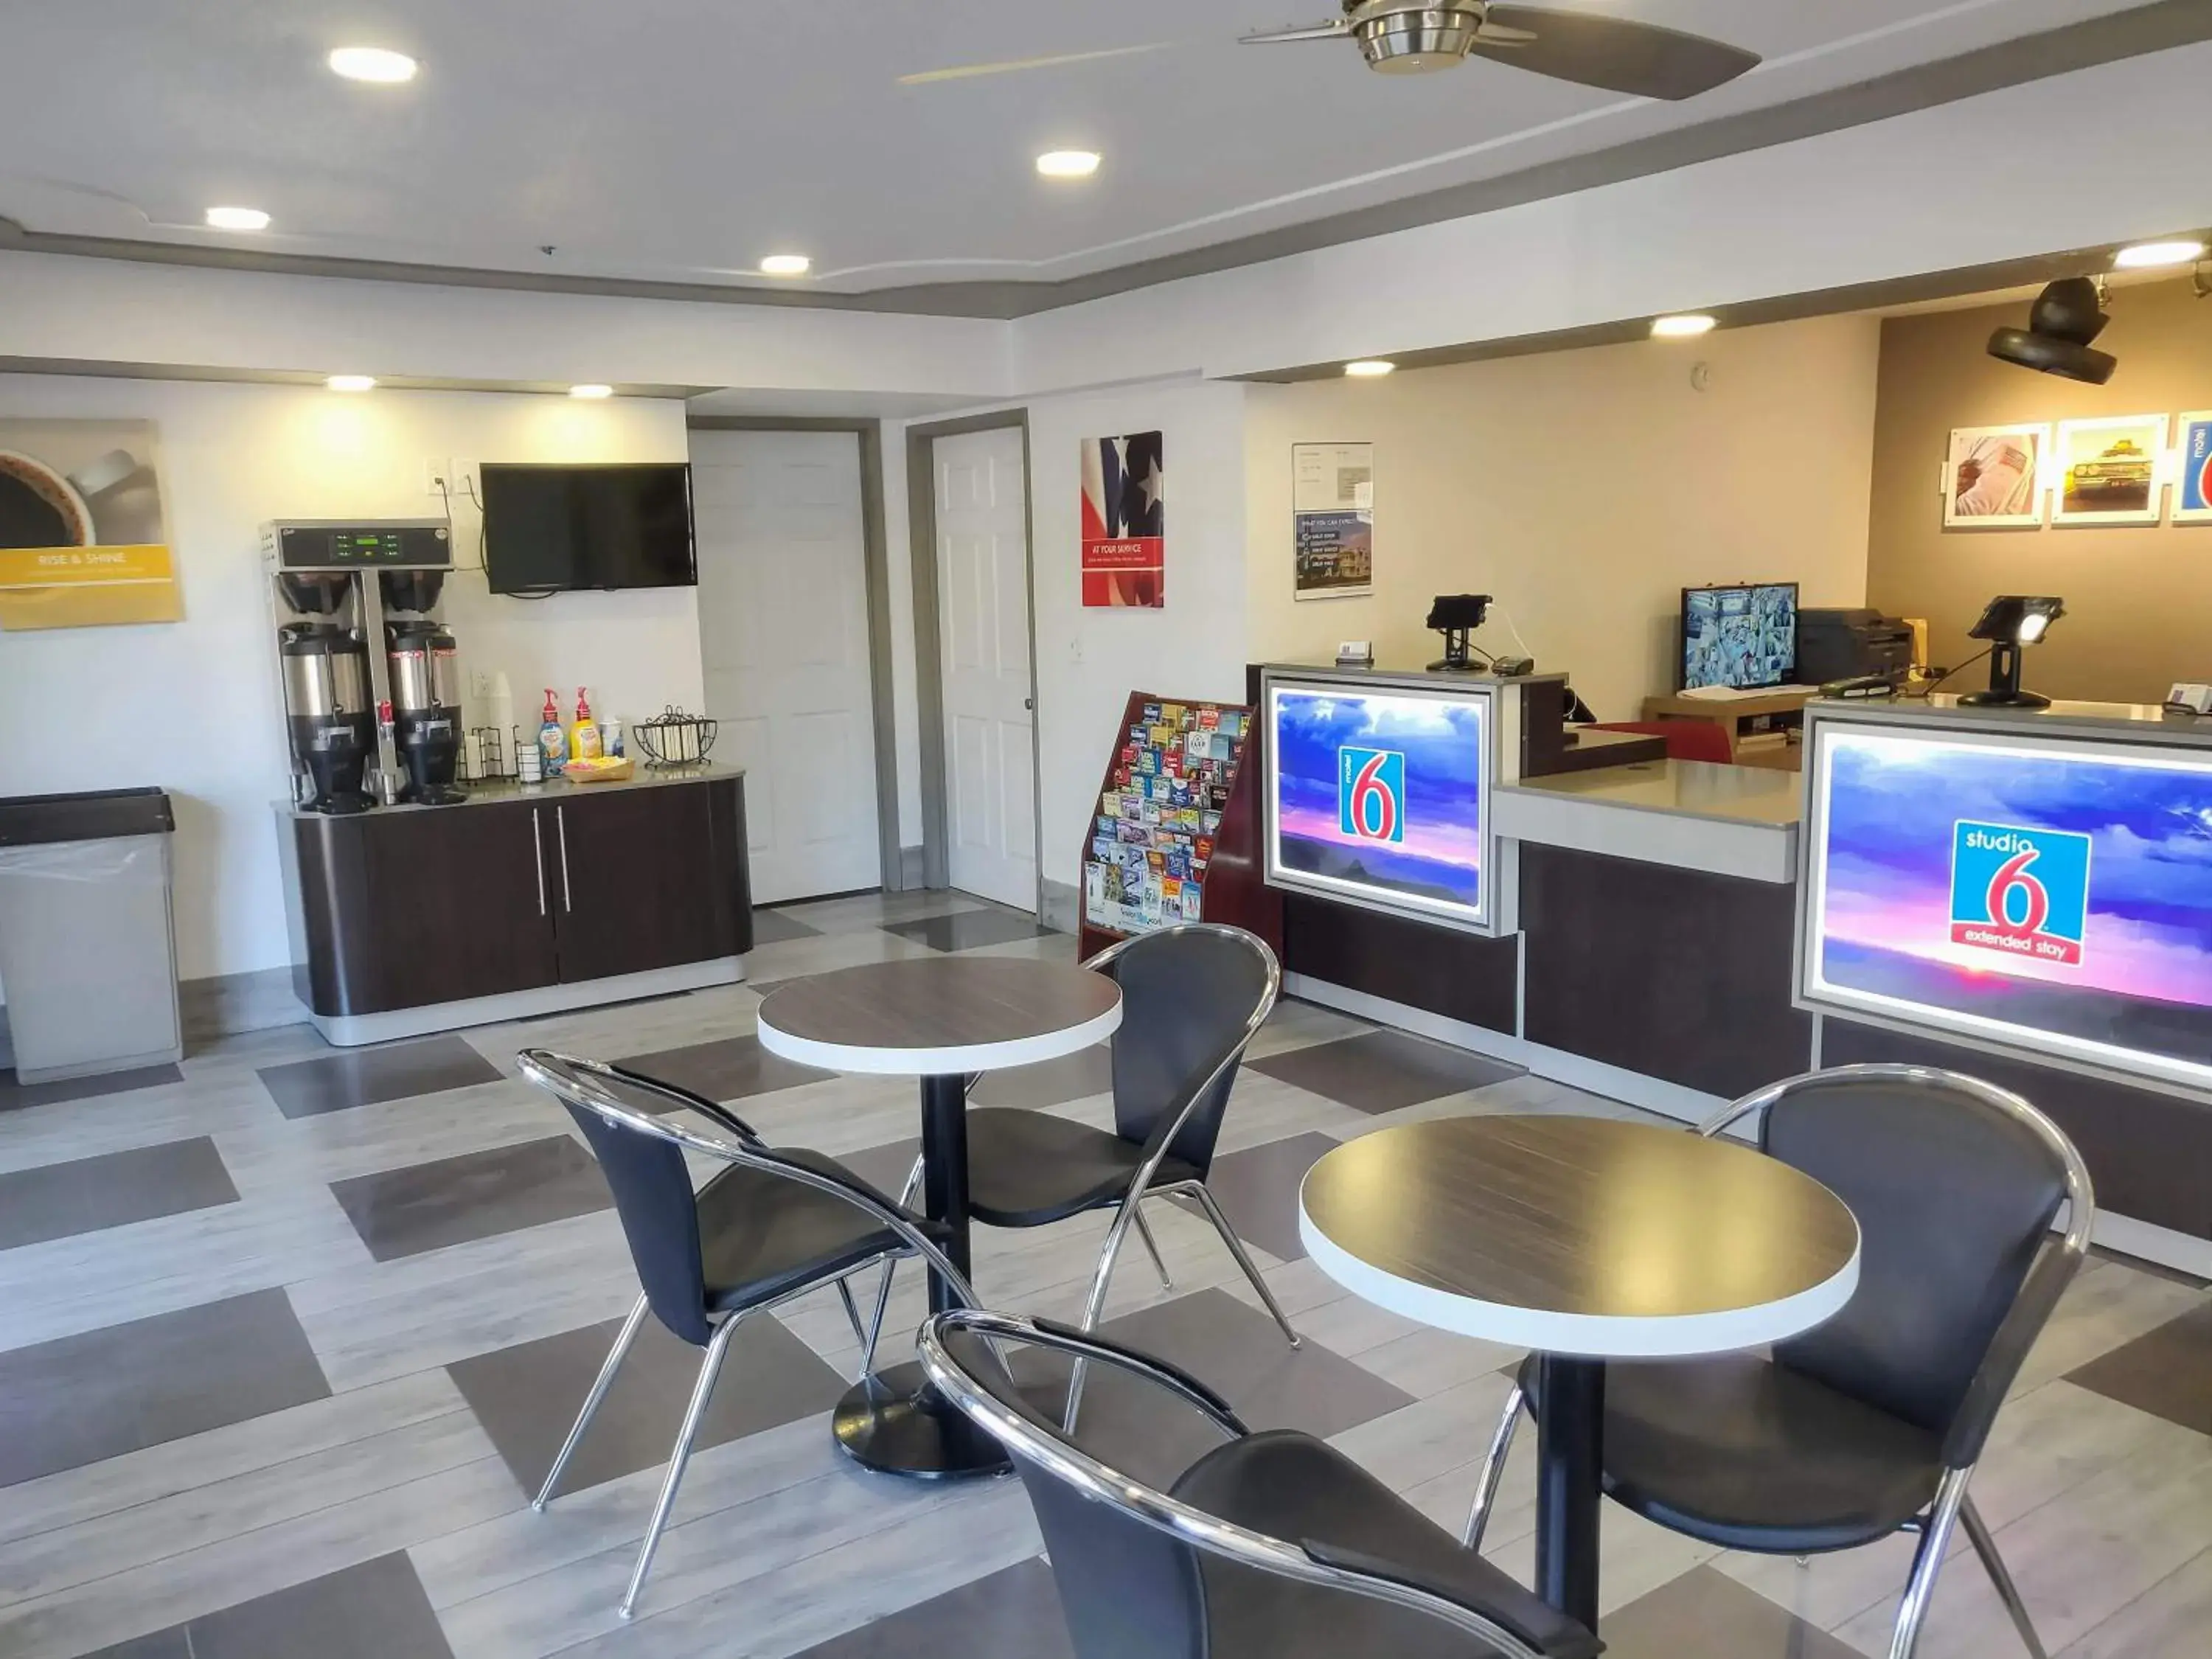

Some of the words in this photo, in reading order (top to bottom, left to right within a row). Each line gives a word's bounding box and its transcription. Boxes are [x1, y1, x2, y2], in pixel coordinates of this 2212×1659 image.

[38, 554, 67, 566] RISE
[71, 554, 81, 565] &
[86, 552, 126, 564] SHINE
[1092, 545, 1099, 554] AT
[1100, 544, 1117, 554] YOUR
[1117, 543, 1142, 554] SERVICE
[1350, 752, 1397, 841] 6
[1966, 830, 2033, 854] studio
[1986, 849, 2050, 932] 6
[1965, 928, 2032, 951] extended
[2036, 940, 2067, 959] stay
